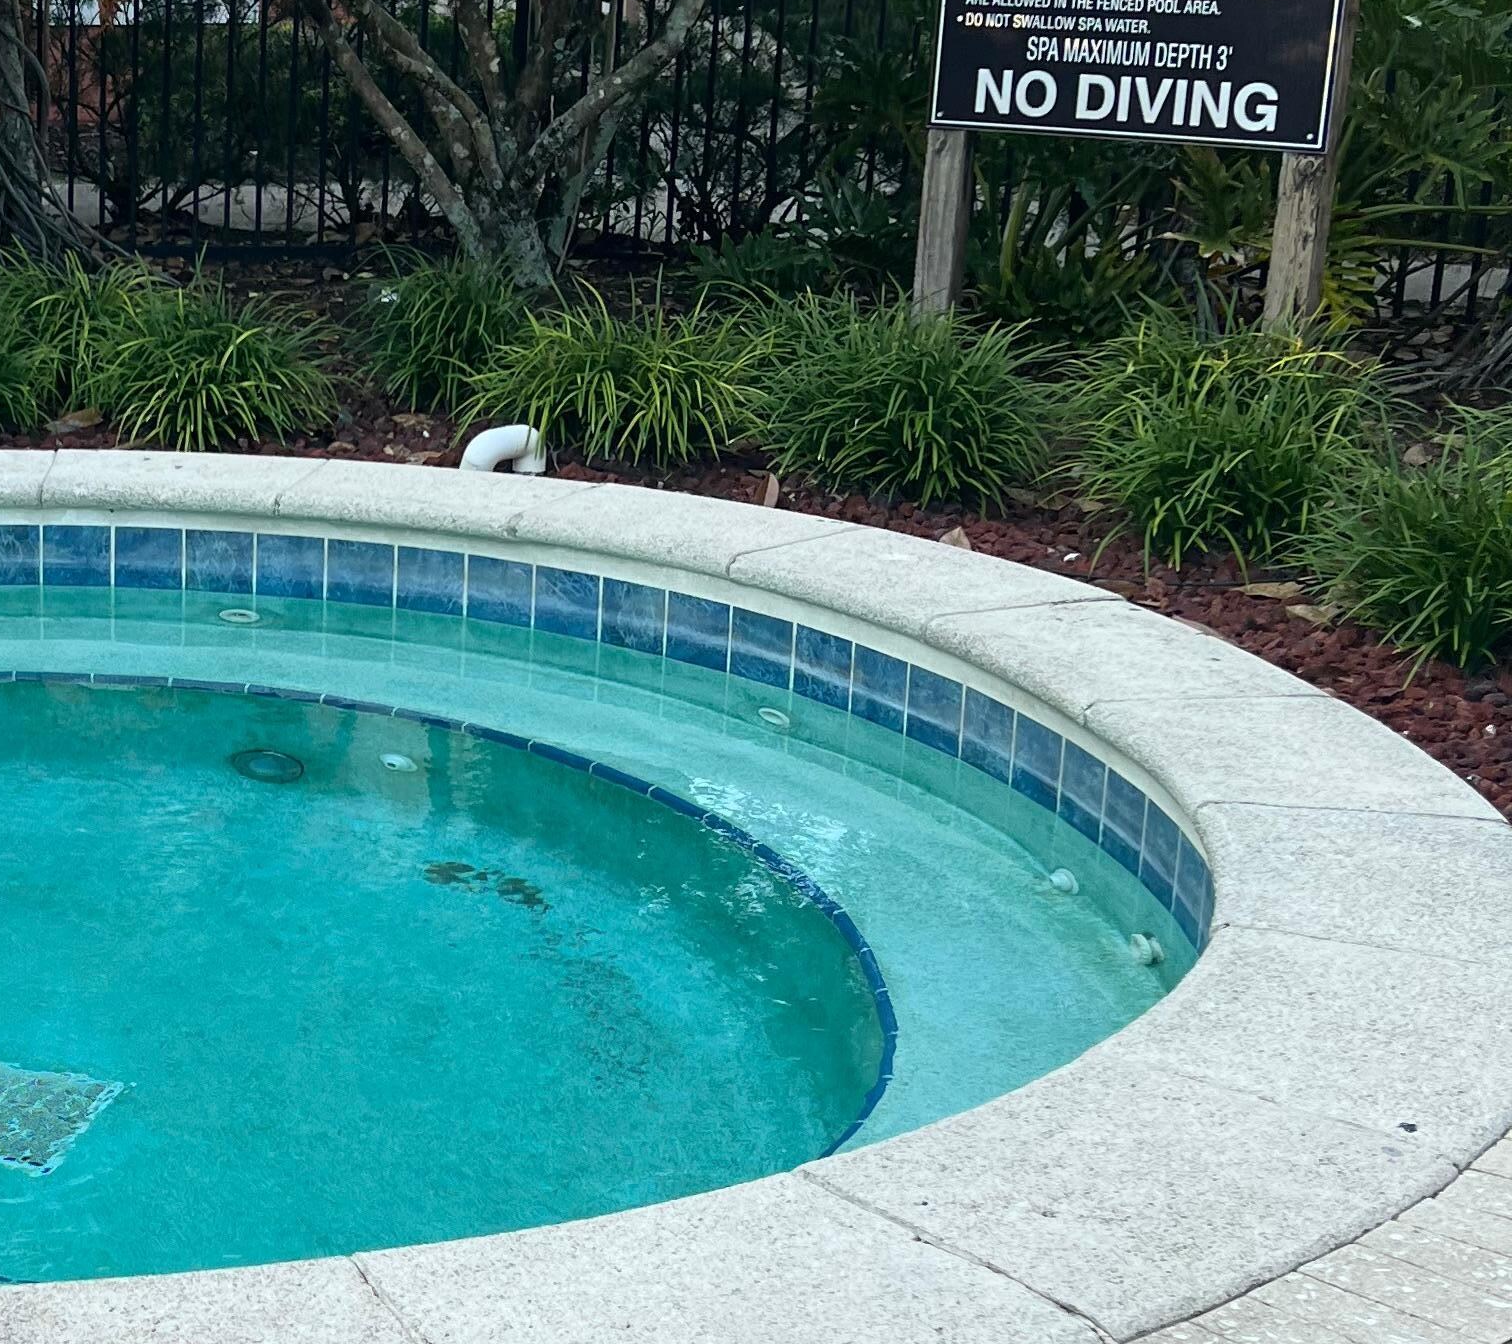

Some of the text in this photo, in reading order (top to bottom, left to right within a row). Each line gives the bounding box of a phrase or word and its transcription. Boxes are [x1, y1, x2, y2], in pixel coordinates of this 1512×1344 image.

[964, 11, 1151, 34] DO NOT SWALLOW SPA WATER.
[1182, 0, 1222, 16] AREA.
[1026, 35, 1234, 71] SPA MAXIMUM DEPTH 3'
[974, 68, 1279, 132] NO DIVING
